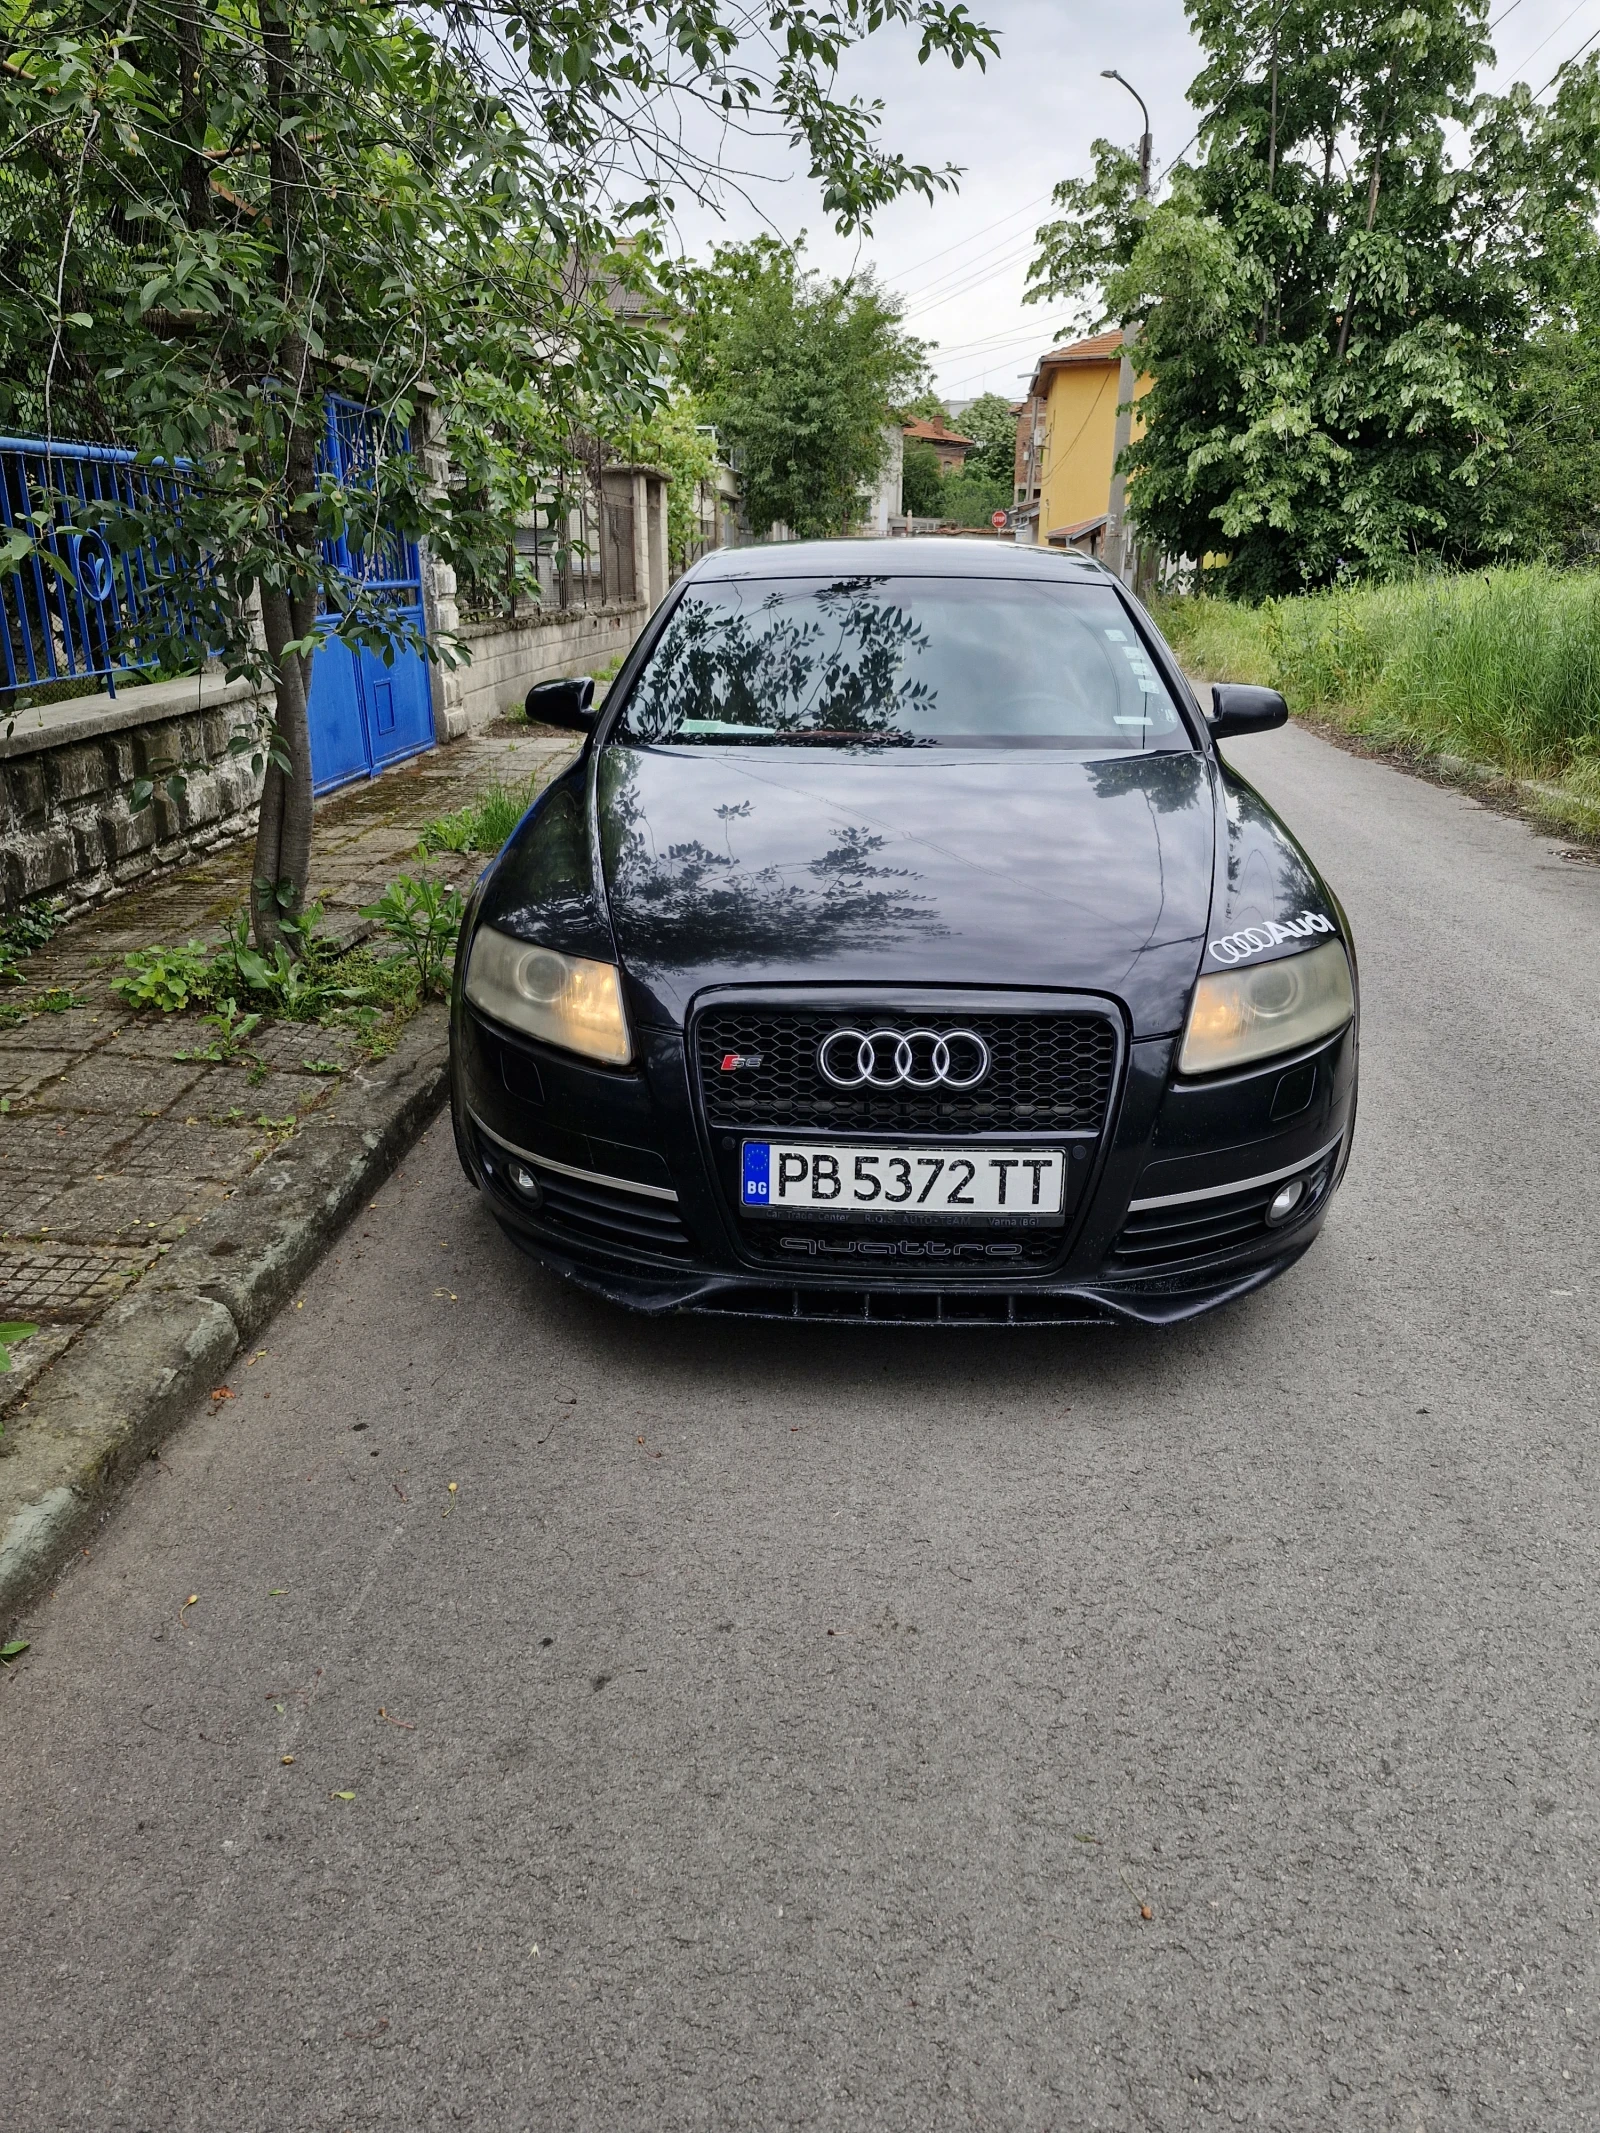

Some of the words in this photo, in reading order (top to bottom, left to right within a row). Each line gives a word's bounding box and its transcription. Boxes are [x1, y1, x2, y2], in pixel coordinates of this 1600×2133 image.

[778, 1152, 842, 1199] PB
[853, 1155, 976, 1204] 5372
[988, 1159, 1053, 1205] TT
[747, 1181, 767, 1195] BG
[766, 1209, 782, 1218] Car
[786, 1210, 813, 1220] Trade
[818, 1211, 850, 1222] Center
[988, 1216, 1016, 1226] Varna
[1019, 1216, 1039, 1226] (BG)
[780, 1236, 1023, 1255] quattro
